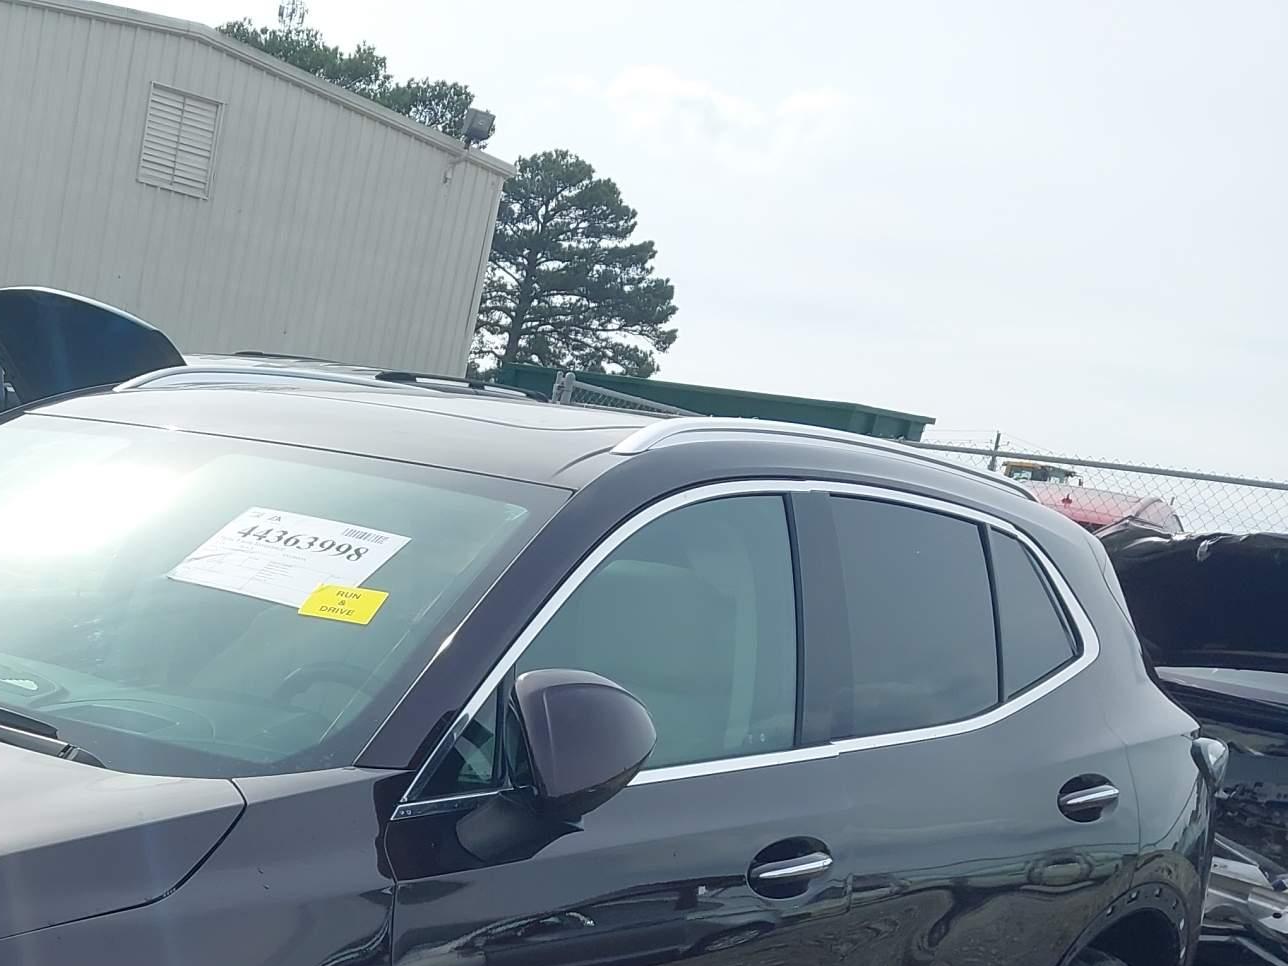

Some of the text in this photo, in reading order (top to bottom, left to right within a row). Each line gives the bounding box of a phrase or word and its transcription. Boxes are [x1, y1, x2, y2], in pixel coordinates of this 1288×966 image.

[237, 524, 369, 562] 44363998
[335, 589, 362, 600] RUN
[319, 605, 355, 617] DRIVE
